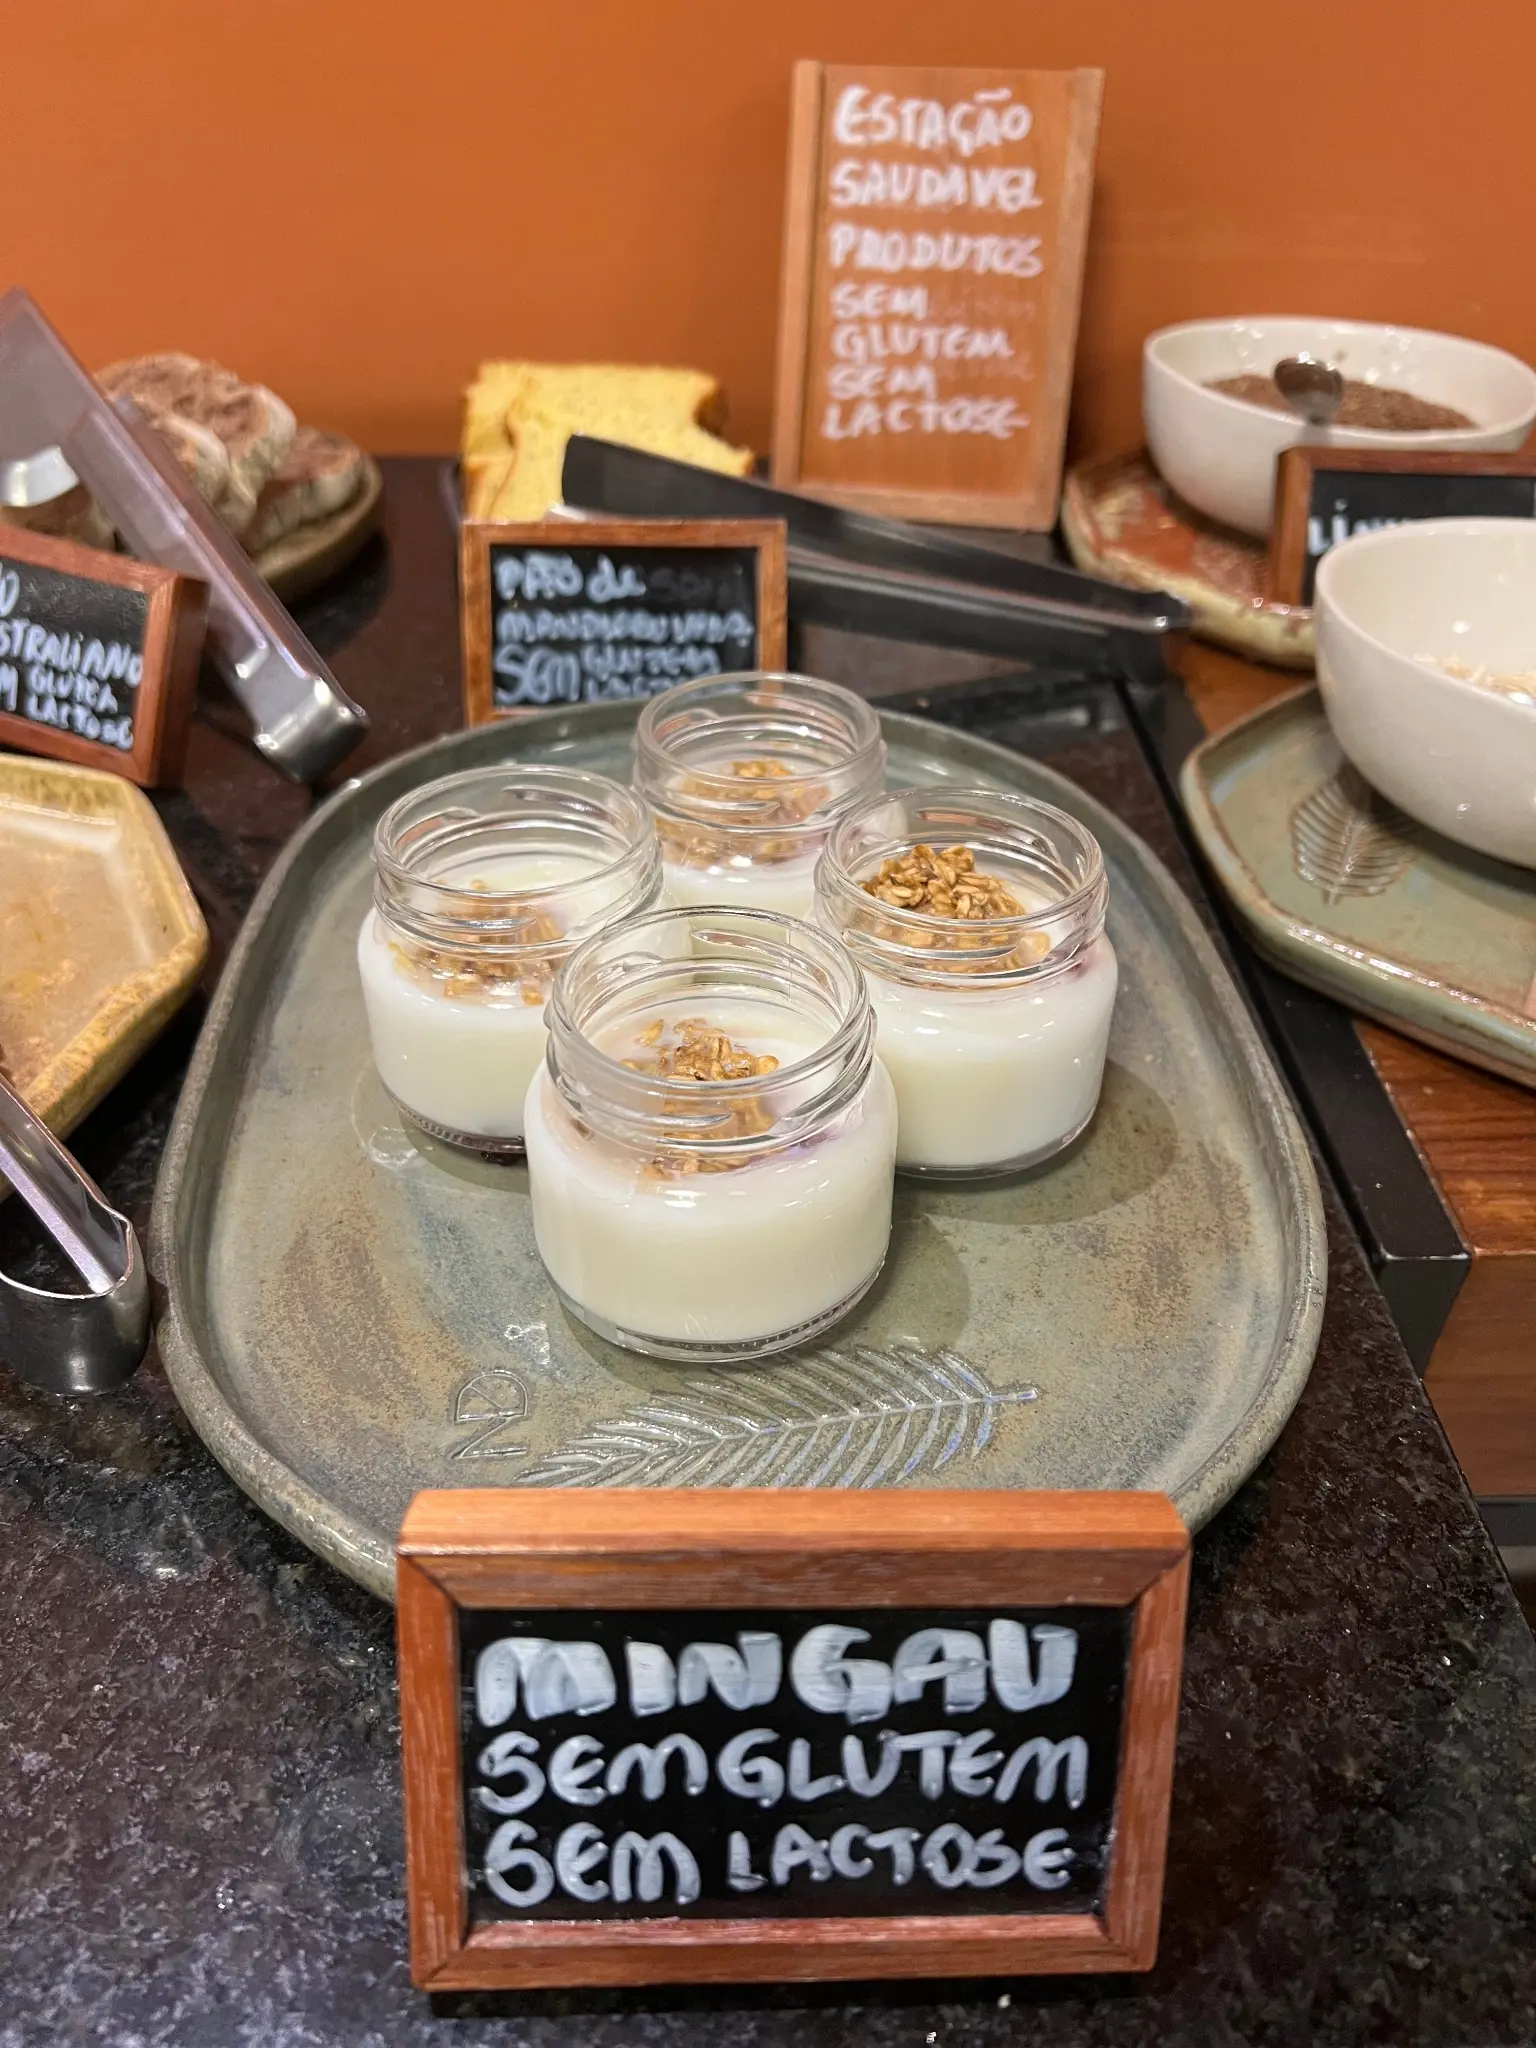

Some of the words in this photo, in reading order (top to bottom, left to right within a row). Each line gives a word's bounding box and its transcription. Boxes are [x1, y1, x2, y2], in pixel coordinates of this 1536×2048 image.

[834, 84, 1032, 157] ESTAÇÃO
[830, 222, 1042, 277] PRODUTOS
[830, 283, 928, 320] SEM
[827, 365, 937, 399] SEM
[823, 399, 1030, 440] LACTOSE
[475, 1618, 1079, 1728] MINGAU
[476, 1730, 709, 1816] SEM
[717, 1727, 1090, 1810] GLUTEM
[483, 1819, 702, 1907] SEM
[726, 1821, 1076, 1892] LACTOSE
